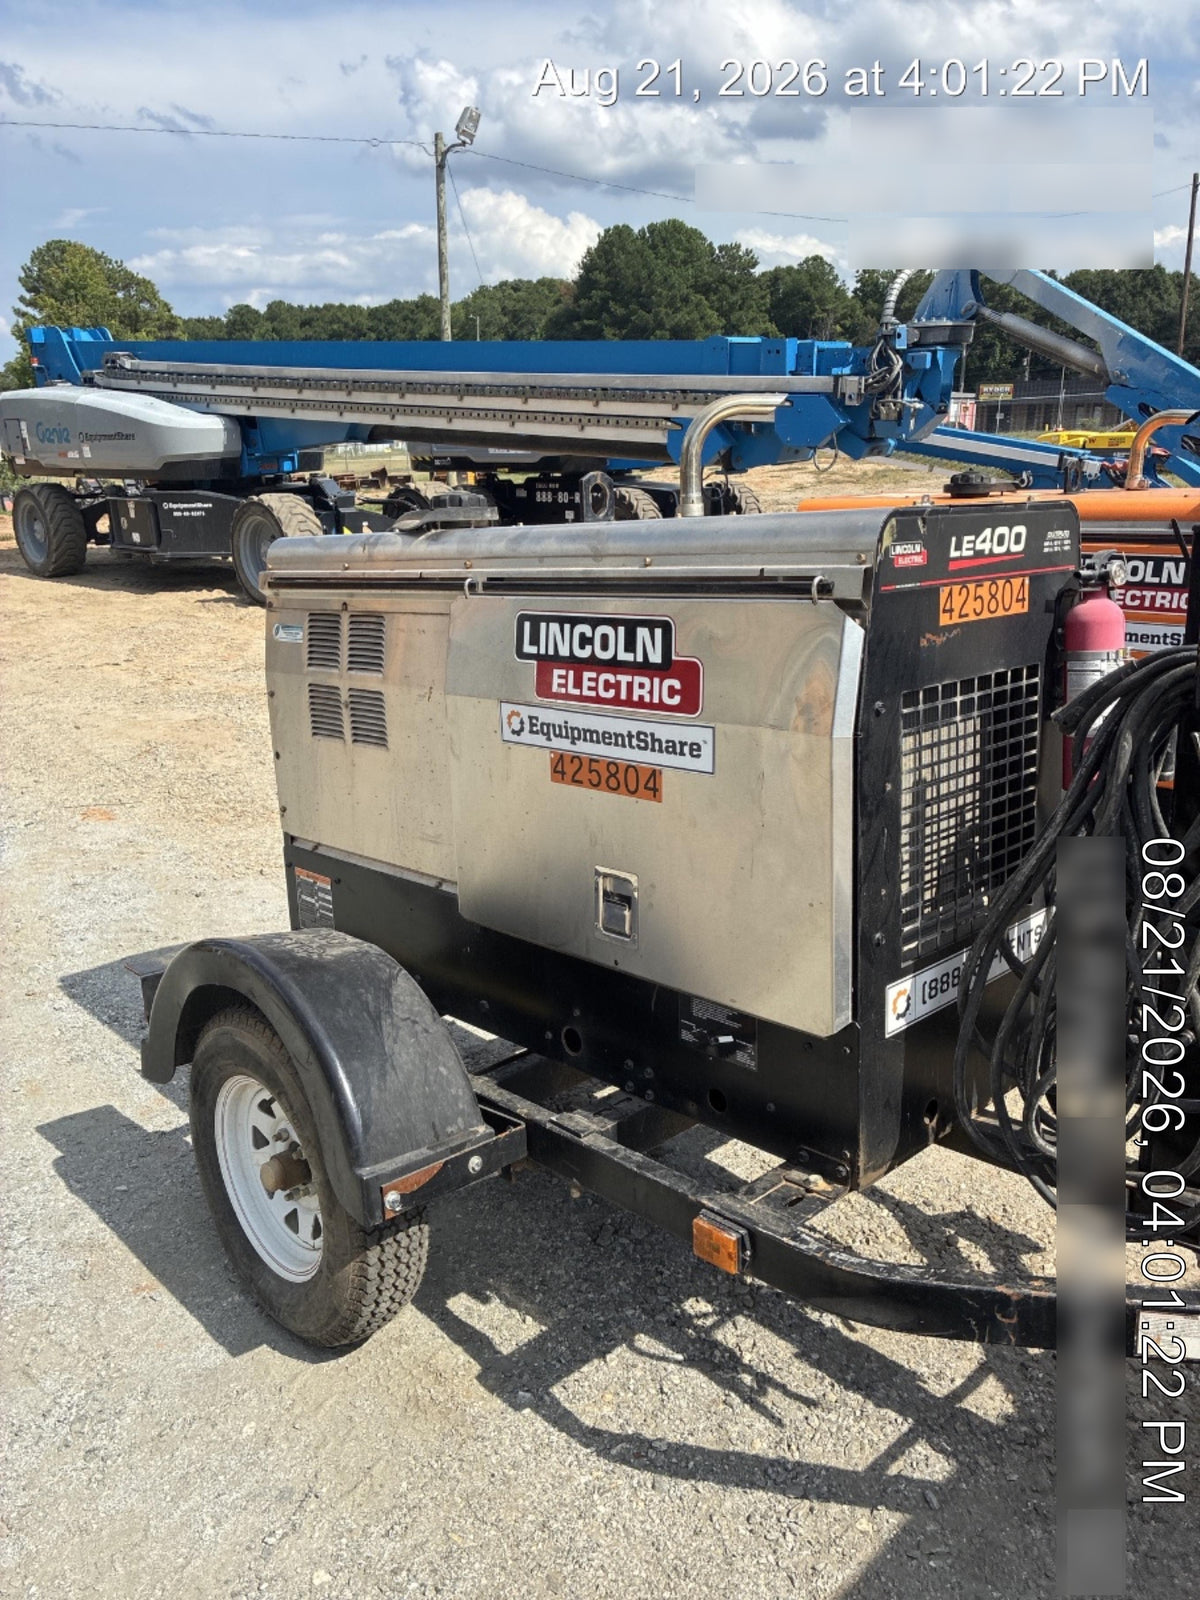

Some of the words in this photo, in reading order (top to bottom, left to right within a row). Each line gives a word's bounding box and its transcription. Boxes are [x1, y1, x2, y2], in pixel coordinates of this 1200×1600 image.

[36, 421, 71, 444] Genie
[891, 543, 921, 555] LINCOLN
[949, 524, 1027, 558] LE400
[942, 578, 1026, 620] 425804
[522, 620, 662, 664] LINCOLN
[552, 668, 681, 706] ELECTRIC
[553, 754, 660, 798] 425804
